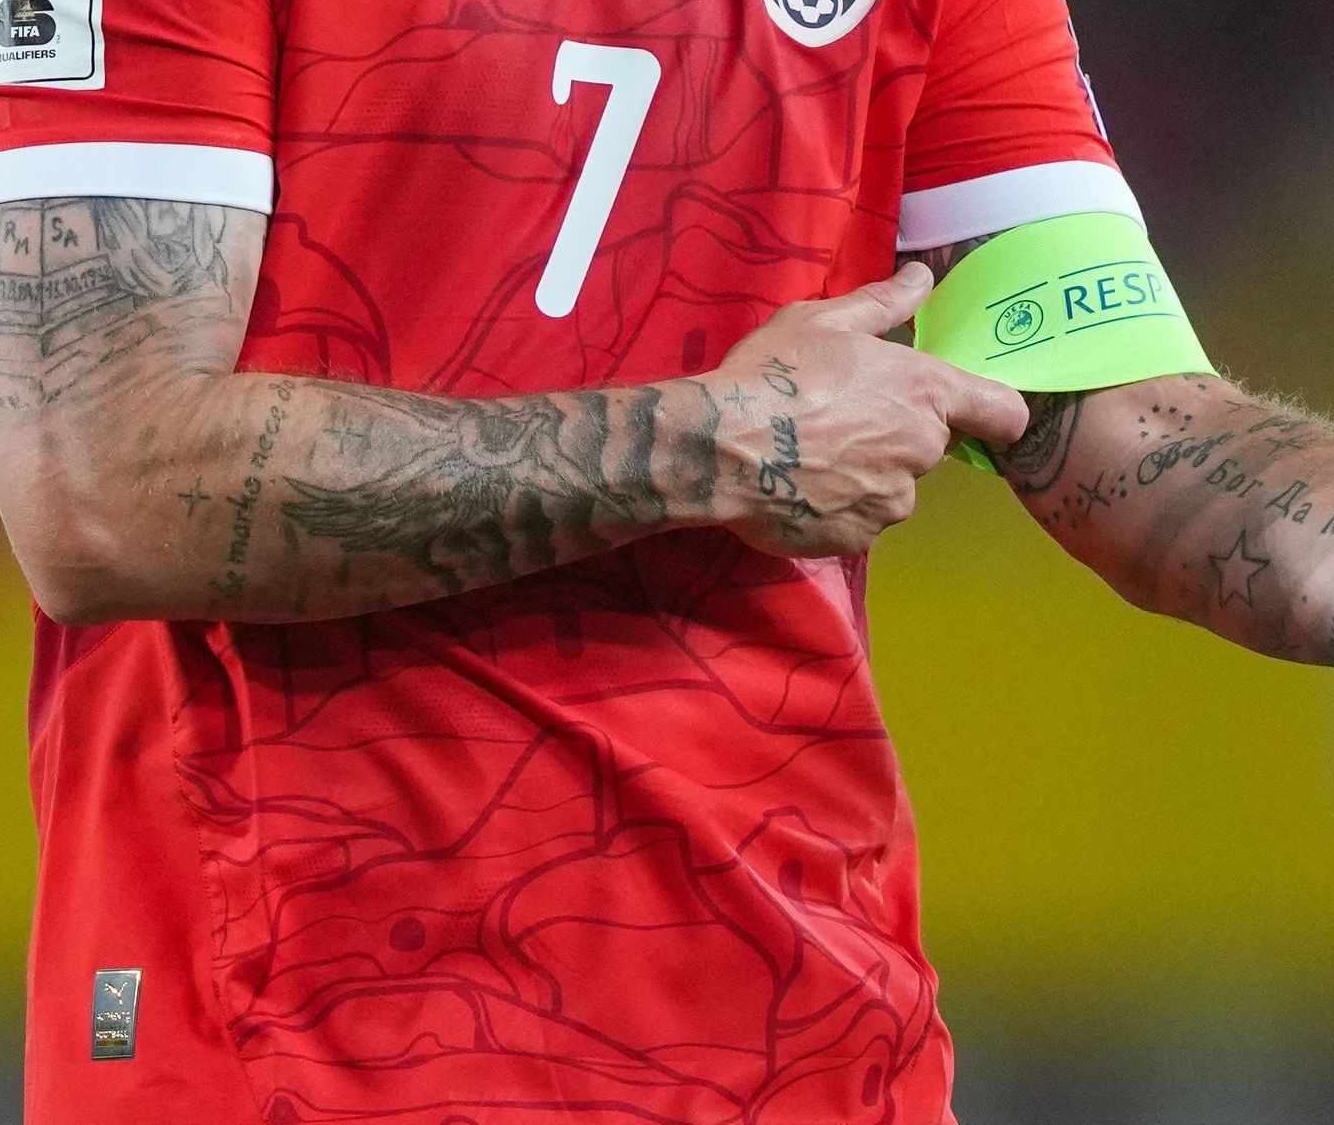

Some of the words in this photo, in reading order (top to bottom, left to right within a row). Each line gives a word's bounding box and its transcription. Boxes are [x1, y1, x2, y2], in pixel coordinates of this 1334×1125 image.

[10, 24, 40, 39] FIFA
[536, 40, 661, 317] 7
[1004, 302, 1031, 319] UEFA
[1204, 458, 1264, 499] Бог
[1264, 479, 1313, 526] Да
